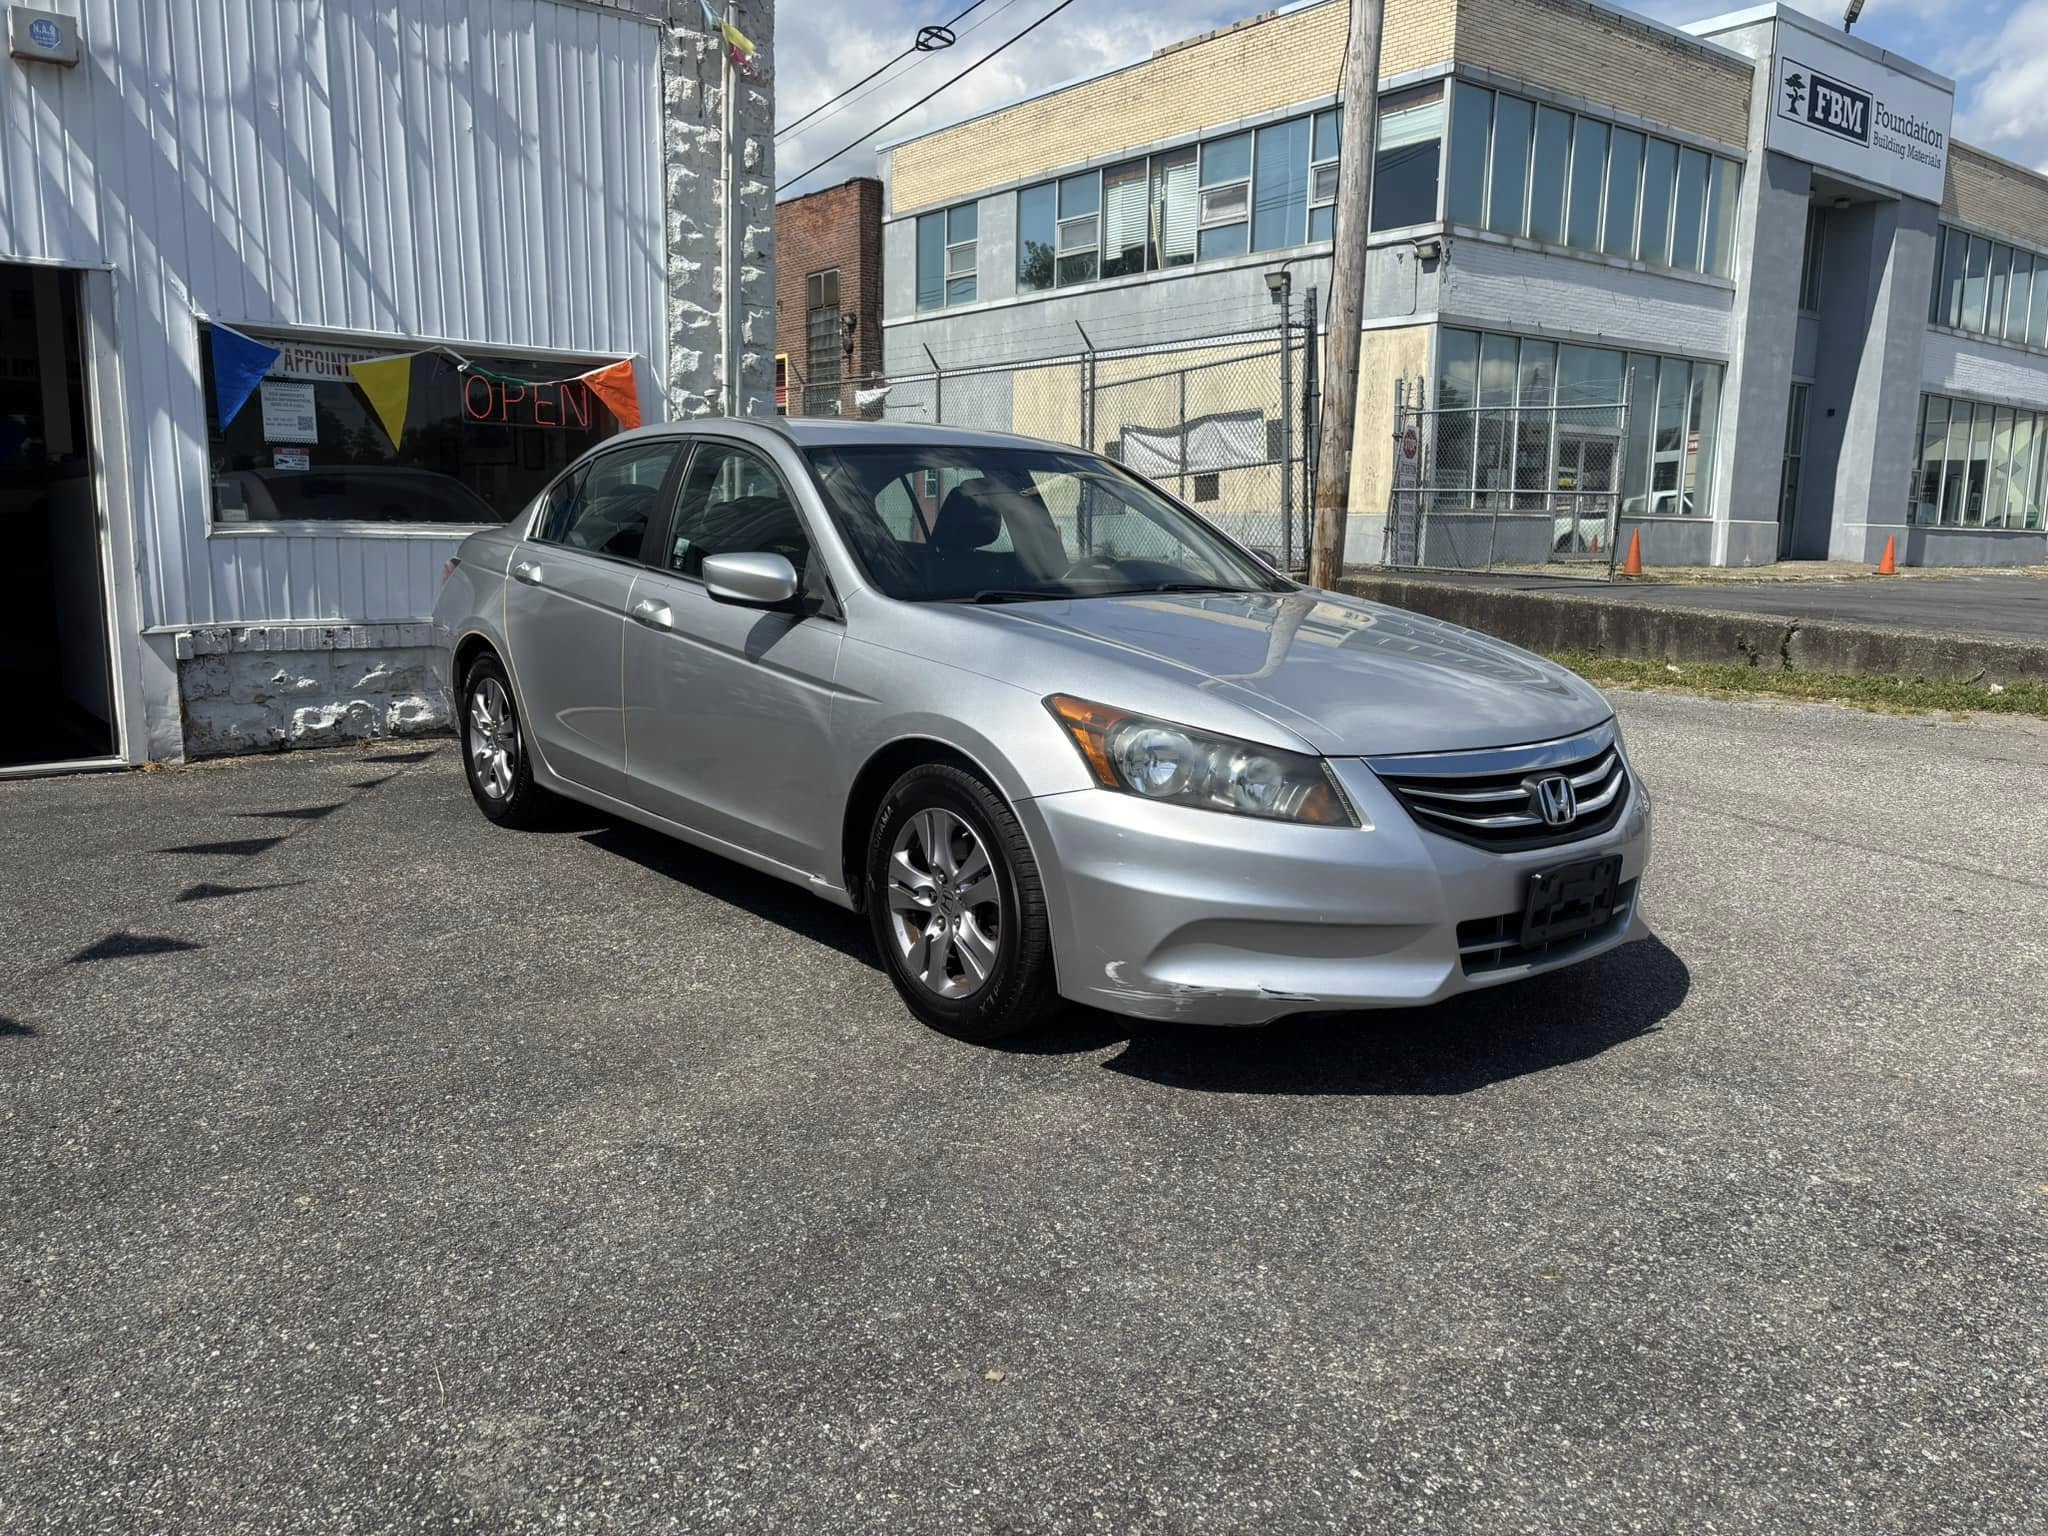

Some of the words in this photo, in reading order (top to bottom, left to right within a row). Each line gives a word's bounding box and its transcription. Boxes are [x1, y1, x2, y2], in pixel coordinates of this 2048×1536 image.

[1815, 84, 1864, 134] FBM
[1874, 101, 1943, 150] Foundation
[1873, 131, 1906, 160] Building
[1906, 144, 1942, 169] Materials
[284, 348, 375, 376] APPOINT
[465, 375, 588, 427] OPEN
